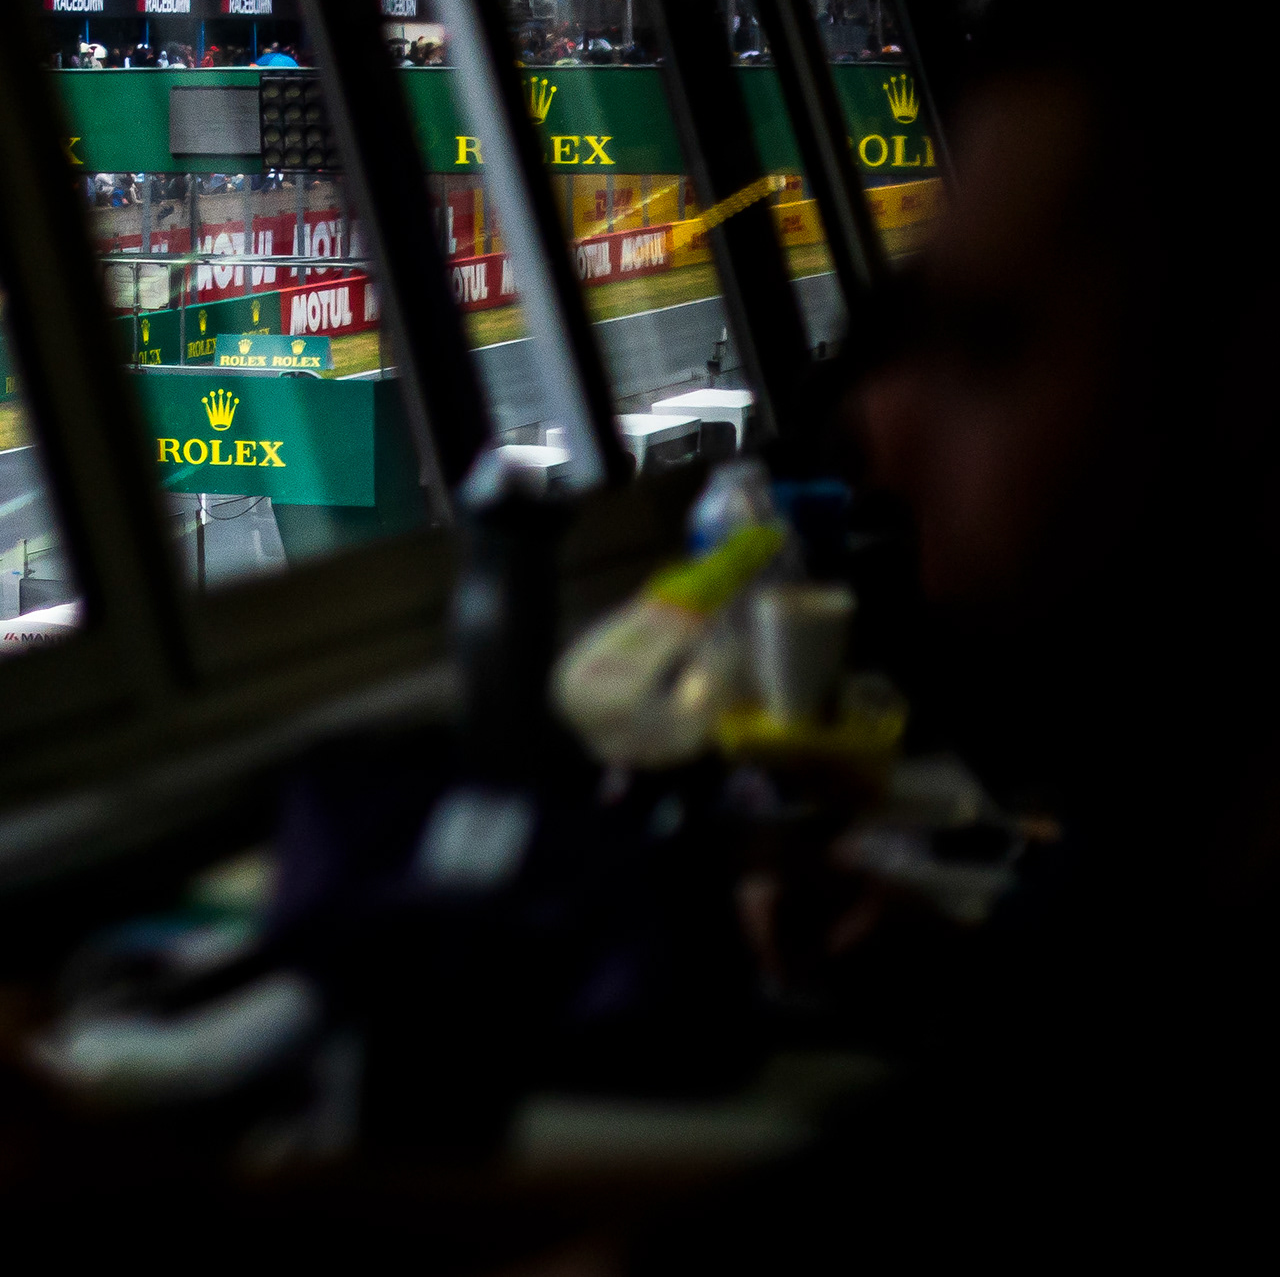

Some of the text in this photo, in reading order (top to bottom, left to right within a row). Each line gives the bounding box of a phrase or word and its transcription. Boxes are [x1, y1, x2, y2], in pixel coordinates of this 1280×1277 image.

[454, 135, 616, 165] REX
[576, 241, 612, 280] OTUL
[452, 262, 490, 306] OTUL
[290, 286, 354, 335] MOTUL
[220, 355, 321, 368] ROLEX ROLEX
[157, 438, 287, 468] ROLEX
